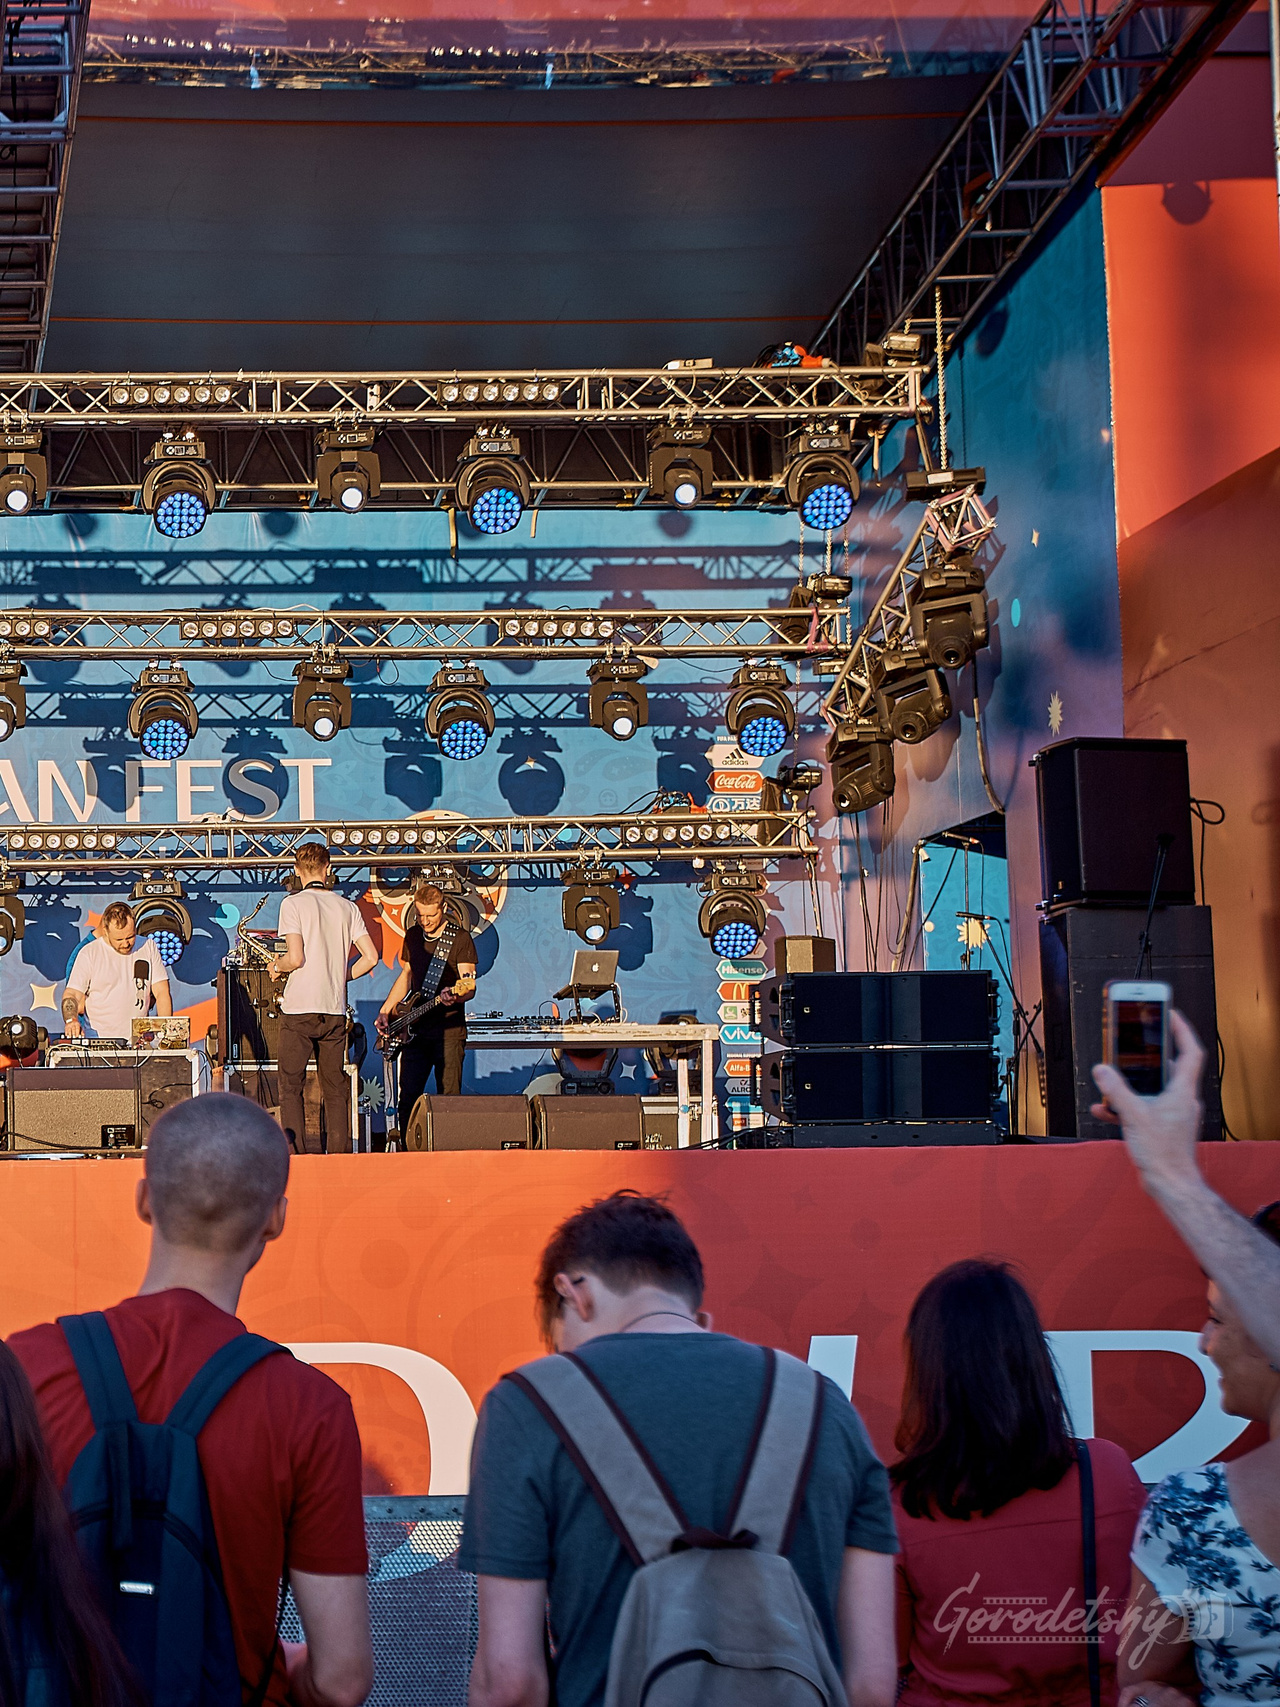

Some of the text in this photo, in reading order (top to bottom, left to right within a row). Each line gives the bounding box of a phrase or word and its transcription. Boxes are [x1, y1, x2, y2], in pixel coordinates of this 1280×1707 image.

[125, 758, 332, 822] FEST
[731, 798, 761, 811] 万达
[722, 965, 763, 974] Hisense
